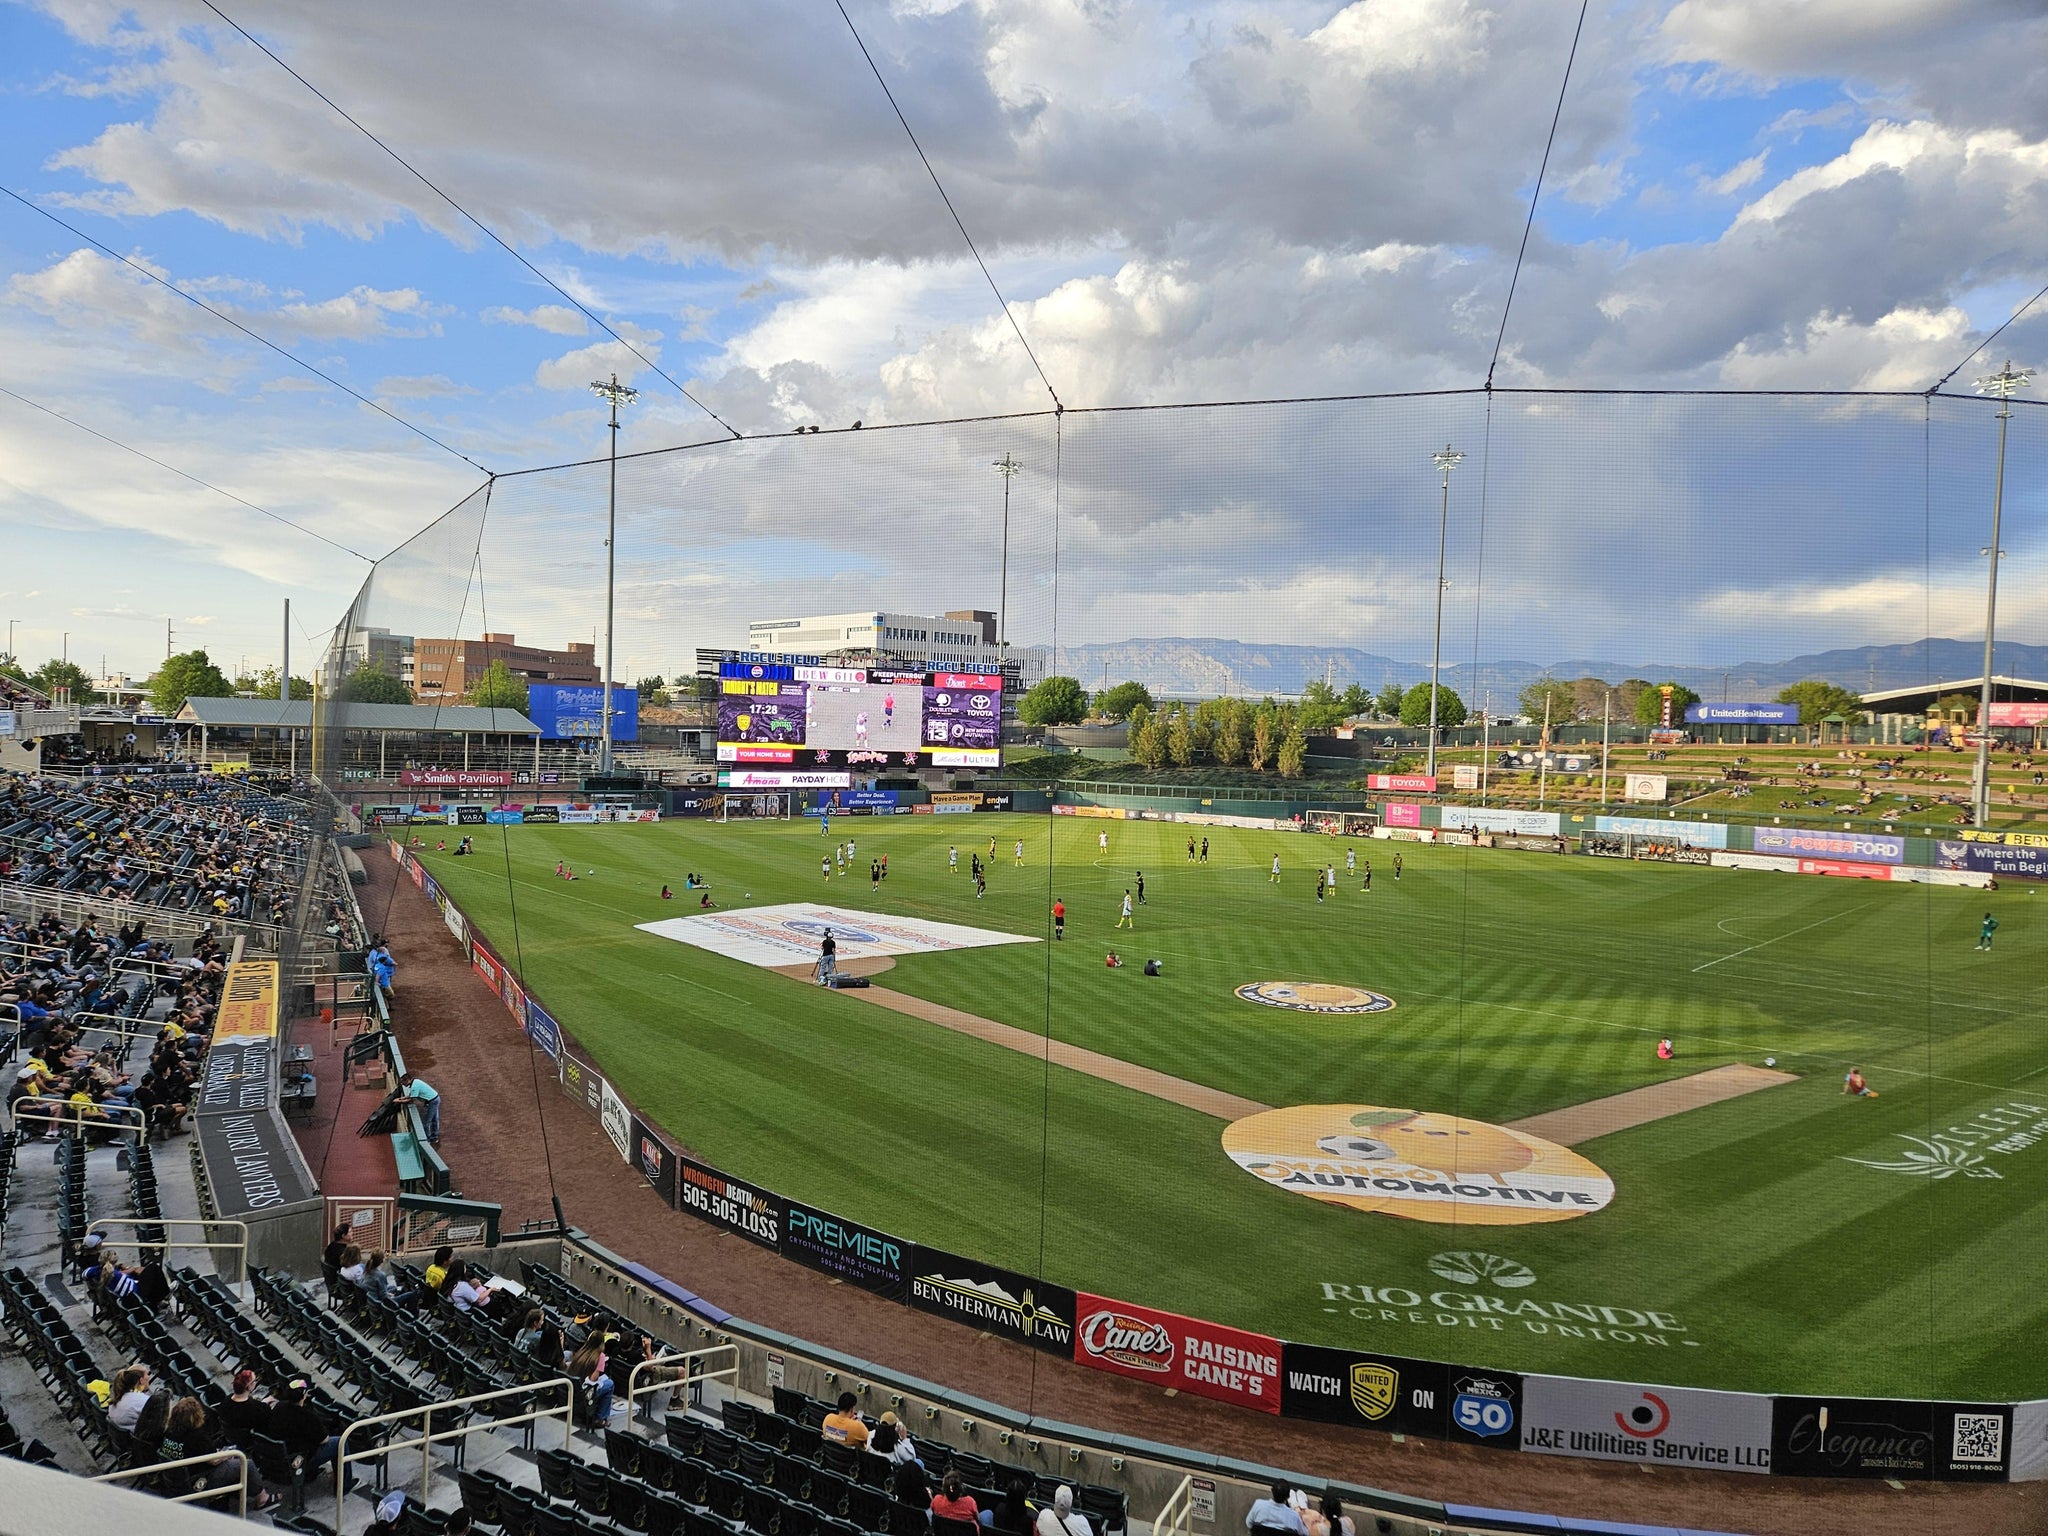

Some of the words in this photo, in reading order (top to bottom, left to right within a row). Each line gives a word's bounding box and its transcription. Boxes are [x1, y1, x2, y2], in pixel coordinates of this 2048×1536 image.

[739, 651, 777, 664] RGCU
[782, 654, 820, 666] FIELD
[927, 660, 960, 673] RGCU
[965, 663, 999, 675] FIELD
[797, 670, 827, 680] IBEW
[835, 671, 853, 681] 611
[750, 704, 777, 714] 17:28
[967, 709, 993, 717] TOYOTA
[1711, 708, 1784, 719] UnitedHealthcare
[741, 732, 746, 740] 0
[740, 750, 755, 758] YOUR
[757, 750, 773, 758] HOME
[968, 756, 996, 764] ULTRA
[345, 770, 371, 778] NICK
[424, 773, 456, 783] Smith's
[459, 774, 503, 783] Pavilion
[518, 776, 529, 784] 19
[792, 775, 825, 784] PAYDAY
[1391, 779, 1426, 787] TOYOTA
[1675, 851, 1708, 860] SANDIA
[1974, 848, 2014, 859] Where
[2016, 849, 2036, 859] the
[1994, 860, 2016, 871] Fun
[2019, 861, 2048, 875] Begi
[228, 974, 272, 1003] Billion
[249, 1003, 270, 1031] Recovered
[216, 1114, 262, 1152] INJURY
[1274, 1160, 1437, 1182] MANGO
[234, 1151, 285, 1208] LAWYERS
[1281, 1172, 1598, 1206] AUTOMOTIVE
[683, 1184, 778, 1242] 505.505.LOSS
[789, 1208, 901, 1270] PREMIER
[788, 1235, 838, 1260] CRYOTHERAPY
[840, 1254, 856, 1267] AND
[857, 1260, 901, 1283] SCULPTING
[913, 1280, 942, 1304] BEN
[944, 1290, 1020, 1330] SHERMAN
[1034, 1319, 1070, 1345] LAW
[1319, 1282, 1421, 1307] RIO
[1430, 1290, 1688, 1333] GRANDE
[1114, 1317, 1147, 1333] Raising
[1349, 1307, 1505, 1332] CREDIT
[1526, 1320, 1690, 1347] UNION
[1083, 1312, 1172, 1354] Cane's
[1184, 1335, 1278, 1378] RAISING
[1184, 1359, 1264, 1396] CANE'S
[1359, 1373, 1389, 1387] UNITED
[1289, 1371, 1341, 1397] WATCH
[1412, 1389, 1435, 1410] ON
[1466, 1386, 1503, 1398] MEXICO
[1474, 1381, 1496, 1391] NEW
[1461, 1401, 1507, 1429] 50
[1523, 1426, 1565, 1450] J&E
[1569, 1430, 1647, 1458] Utilities
[1652, 1442, 1729, 1465] Service
[1735, 1450, 1770, 1468] LLC
